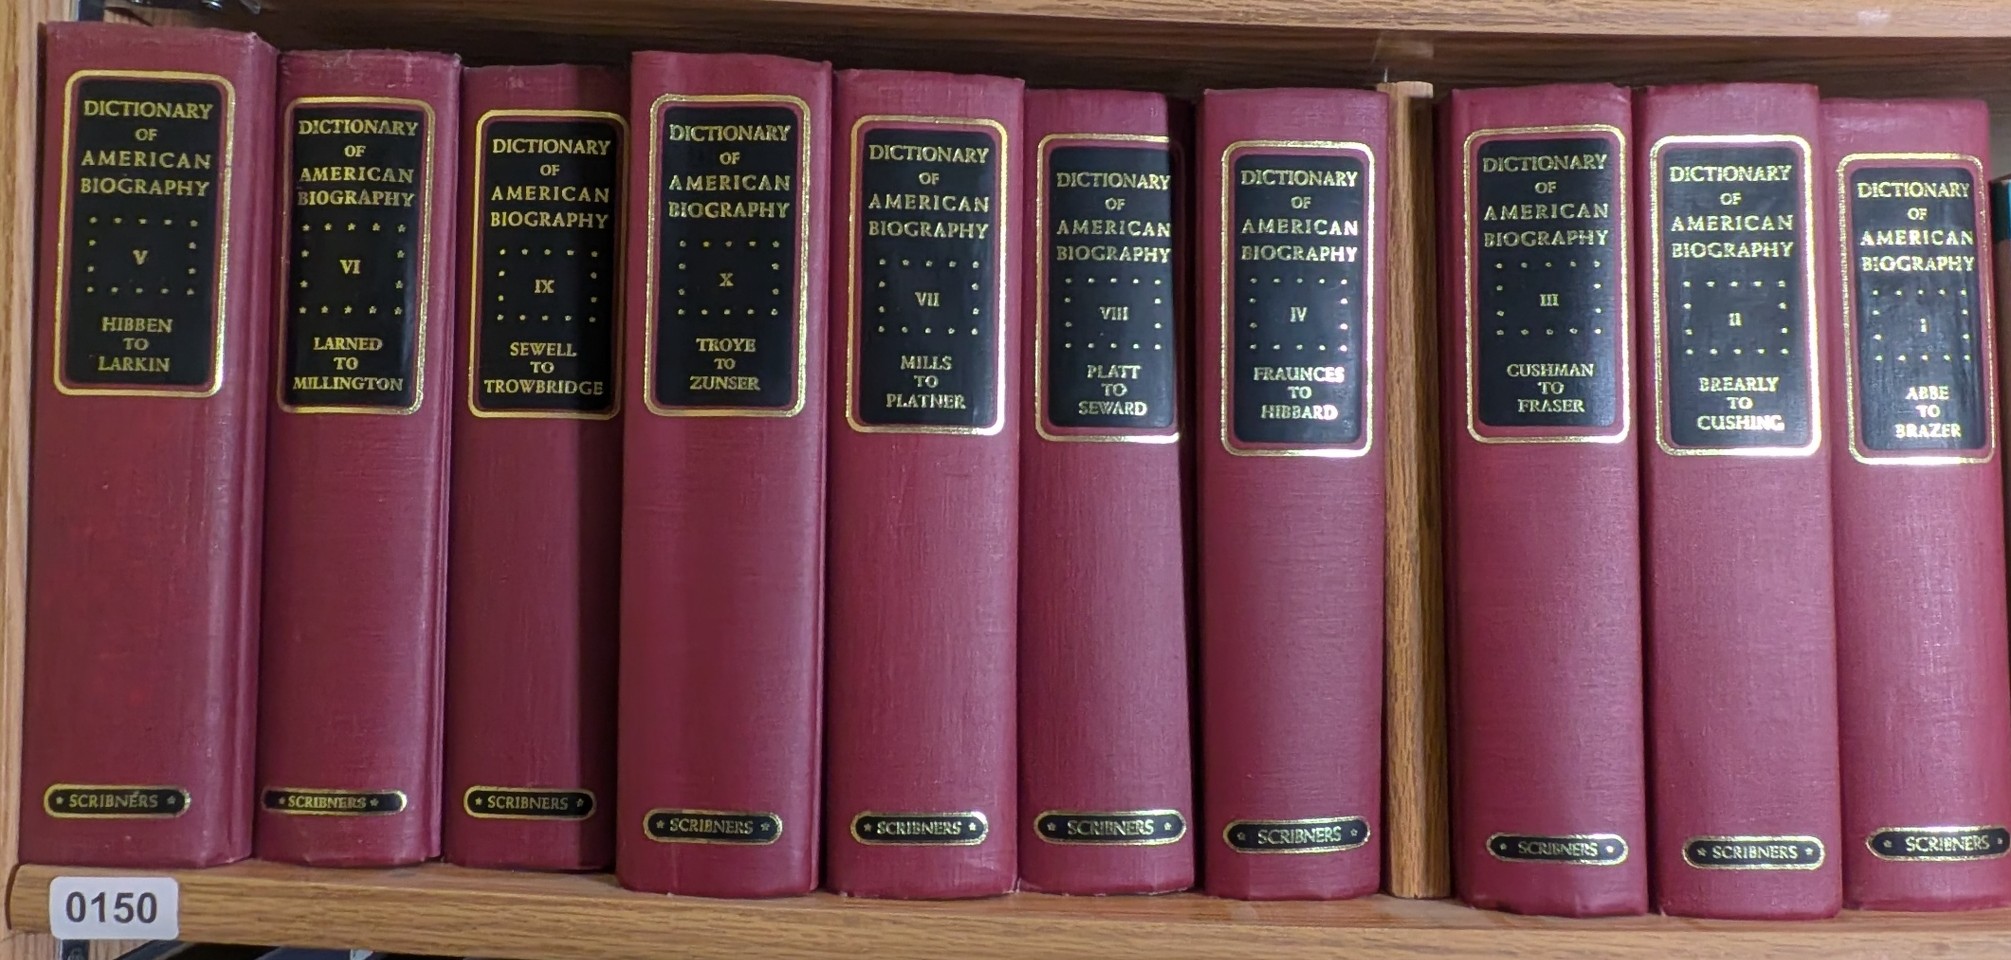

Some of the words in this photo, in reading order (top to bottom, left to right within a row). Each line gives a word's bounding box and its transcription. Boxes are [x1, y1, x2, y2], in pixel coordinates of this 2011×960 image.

[84, 100, 213, 120] DICTIONARY
[135, 127, 157, 141] OF
[299, 119, 418, 138] DICTIONARY
[669, 125, 791, 142] DICTIONARY
[344, 144, 366, 157] OF
[493, 139, 610, 155] DICTIONARY
[869, 145, 989, 163] DICTIONARY
[81, 151, 210, 169] AMERICAN
[720, 151, 740, 165] OF
[1483, 155, 1607, 173] DICTIONARY
[300, 167, 414, 183] AMERICAN
[540, 164, 560, 177] OF
[918, 172, 939, 185] OF
[1241, 169, 1358, 186] DICTIONARY
[1670, 165, 1792, 183] DICTIONARY
[80, 177, 210, 197] BIOGRAPHY
[669, 174, 790, 191] AMERICAN
[1057, 172, 1172, 190] DICTIONARY
[1535, 181, 1557, 194] OF
[298, 189, 415, 207] BIOGRAPHY
[491, 186, 609, 203] AMERICAN
[1858, 181, 1970, 199] DICTIONARY
[869, 194, 990, 212] AMERICAN
[1105, 197, 1126, 210] OF
[1291, 195, 1311, 209] OF
[1720, 192, 1741, 206] OF
[669, 201, 789, 219] BIOGRAPHY
[1484, 203, 1609, 221] AMERICAN
[1908, 207, 1927, 221] OF
[491, 211, 608, 228] BIOGRAPHY
[1242, 219, 1358, 236] AMERICAN
[1671, 215, 1793, 232] AMERICAN
[869, 221, 989, 239] BIOGRAPHY
[1057, 220, 1172, 237] AMERICAN
[1484, 229, 1609, 247] BIOGRAPHY
[1861, 229, 1974, 247] AMERICAN
[1057, 246, 1172, 263] BIOGRAPHY
[1241, 245, 1358, 262] BIOGRAPHY
[1671, 240, 1793, 258] BIOGRAPHY
[133, 250, 148, 265] V
[1862, 255, 1975, 273] BIOGRAPHY
[340, 260, 361, 274] VI
[535, 279, 554, 294] IX
[719, 272, 734, 287] X
[915, 292, 940, 307] VII
[1540, 294, 1558, 306] III
[1100, 306, 1129, 321] VIII
[1290, 306, 1308, 322] IV
[1729, 312, 1742, 326] II
[103, 317, 173, 334] HIBBEN
[124, 337, 149, 351] TO
[313, 337, 382, 351] LARNED
[510, 342, 577, 357] SEWELL
[696, 338, 756, 353] TROYE
[98, 357, 170, 372] LARKIN
[334, 357, 358, 370] TO
[531, 361, 554, 374] TO
[714, 357, 736, 370] TO
[901, 355, 952, 370] MILLS
[1507, 362, 1594, 378] CUSHMAN
[1087, 364, 1141, 380] PLATT
[1253, 366, 1345, 382] FRAUNCES
[293, 375, 403, 391] MILLINGTON
[484, 379, 603, 395] TROWBRIDGE
[690, 376, 760, 391] ZUNSER
[914, 375, 938, 388] TO
[1102, 383, 1127, 396] TO
[1538, 381, 1564, 395] TO
[1699, 376, 1778, 393] BREARLY
[1288, 385, 1312, 399] TO
[1906, 385, 1950, 401] ABBE
[886, 394, 966, 410] PLATNER
[1078, 401, 1147, 416] SEWARD
[1518, 398, 1585, 414] FRASER
[1728, 395, 1753, 410] TO
[1261, 404, 1338, 420] HIBBARD
[1916, 404, 1942, 418] TO
[1697, 414, 1785, 431] CUSHING
[1895, 422, 1962, 440] BRAZER
[69, 793, 159, 808] SCRIBNERS
[288, 795, 366, 809] SCRIBNERS
[487, 795, 569, 810] SCRIBNERS
[669, 818, 753, 834] SCRIBNERS
[877, 819, 961, 835] SCRIBNERS
[1068, 818, 1154, 836] SCRIBNERS
[1258, 825, 1342, 844] SCRIBNERS
[1517, 841, 1598, 858] SCRIBNERS
[1905, 835, 1991, 852] SCRIBNERS
[1712, 845, 1798, 860] SCRIBNERS
[65, 891, 158, 924] 0150
